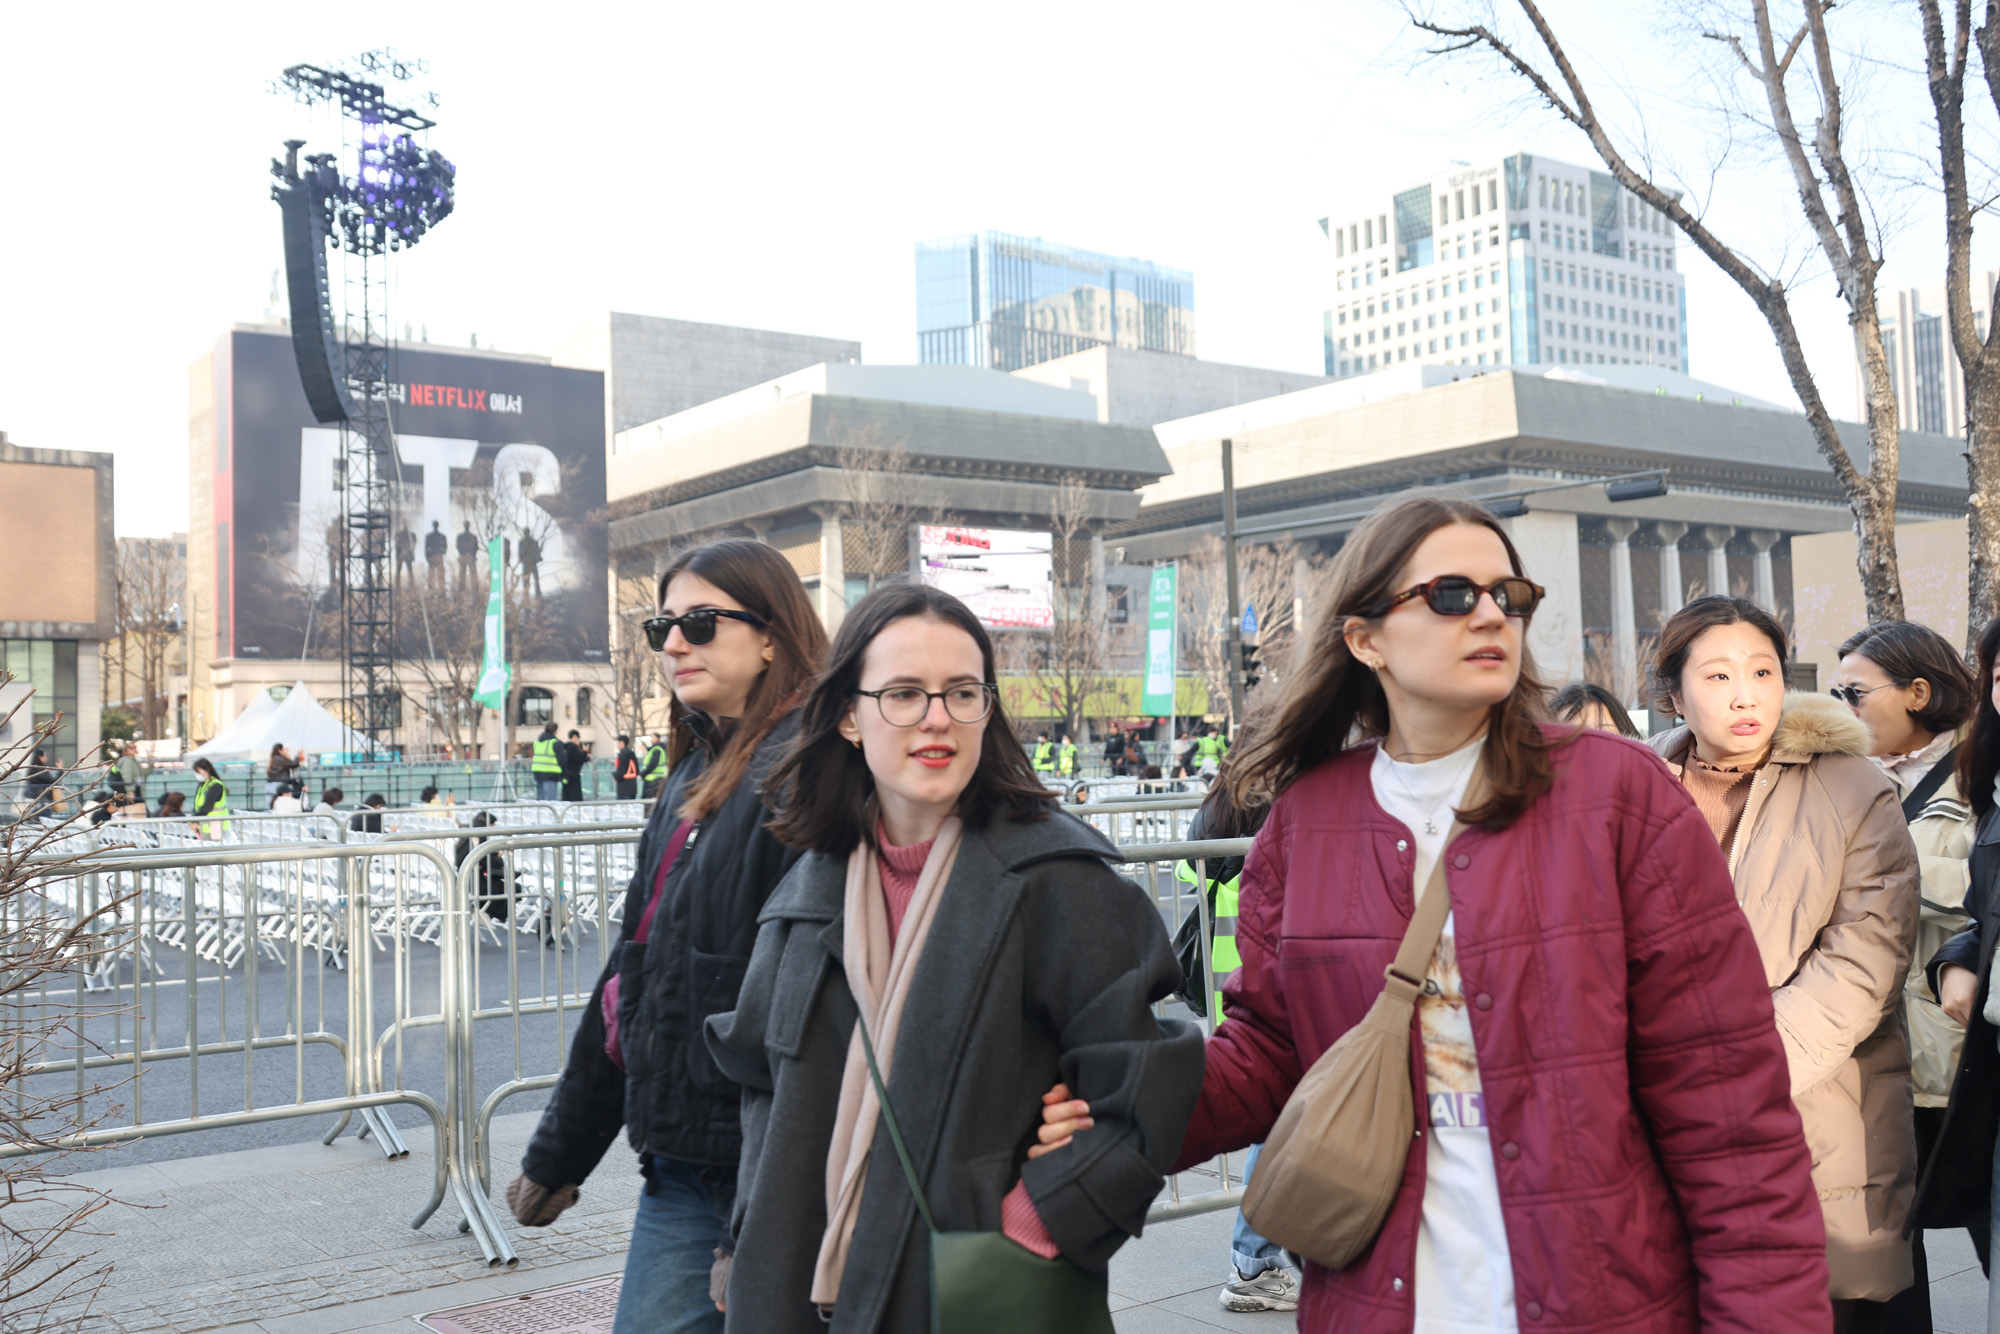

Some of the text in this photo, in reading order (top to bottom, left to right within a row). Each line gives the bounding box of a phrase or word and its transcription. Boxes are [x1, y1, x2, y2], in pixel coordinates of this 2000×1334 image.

[410, 383, 487, 412] NETFLIX
[489, 392, 523, 414] 에서
[299, 427, 563, 598] BTS
[987, 607, 1053, 627] CENTER
